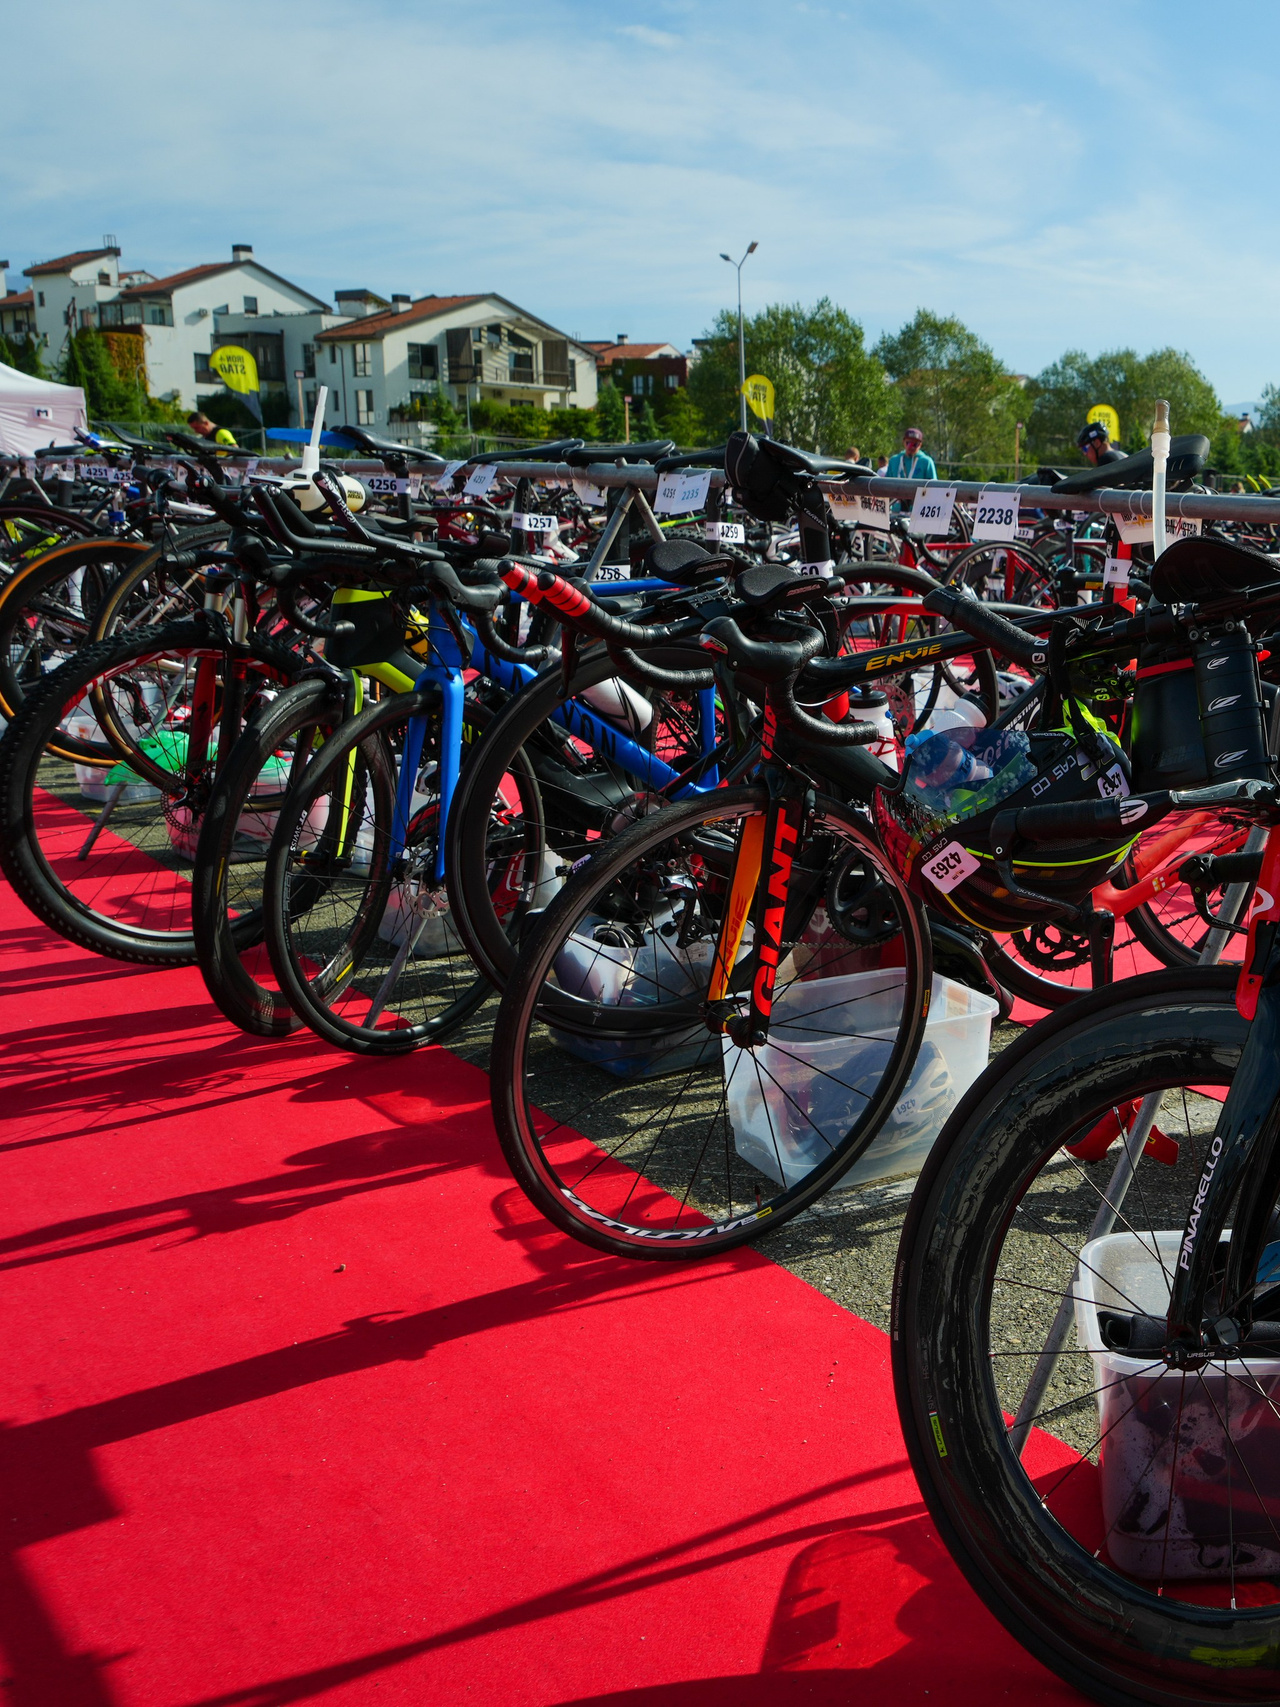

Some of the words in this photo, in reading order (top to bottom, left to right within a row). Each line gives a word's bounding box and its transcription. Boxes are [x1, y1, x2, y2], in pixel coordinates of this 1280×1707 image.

[86, 469, 108, 477] 4251
[368, 478, 397, 491] 4256
[919, 505, 941, 518] 4261
[977, 507, 1013, 526] 2238
[865, 643, 942, 672] ENVIE
[930, 851, 962, 880] 4263
[753, 807, 798, 1017] GIANT
[896, 1098, 916, 1115] 4261
[1179, 1135, 1224, 1272] PINARELLO
[1186, 1351, 1216, 1359] URSUS
